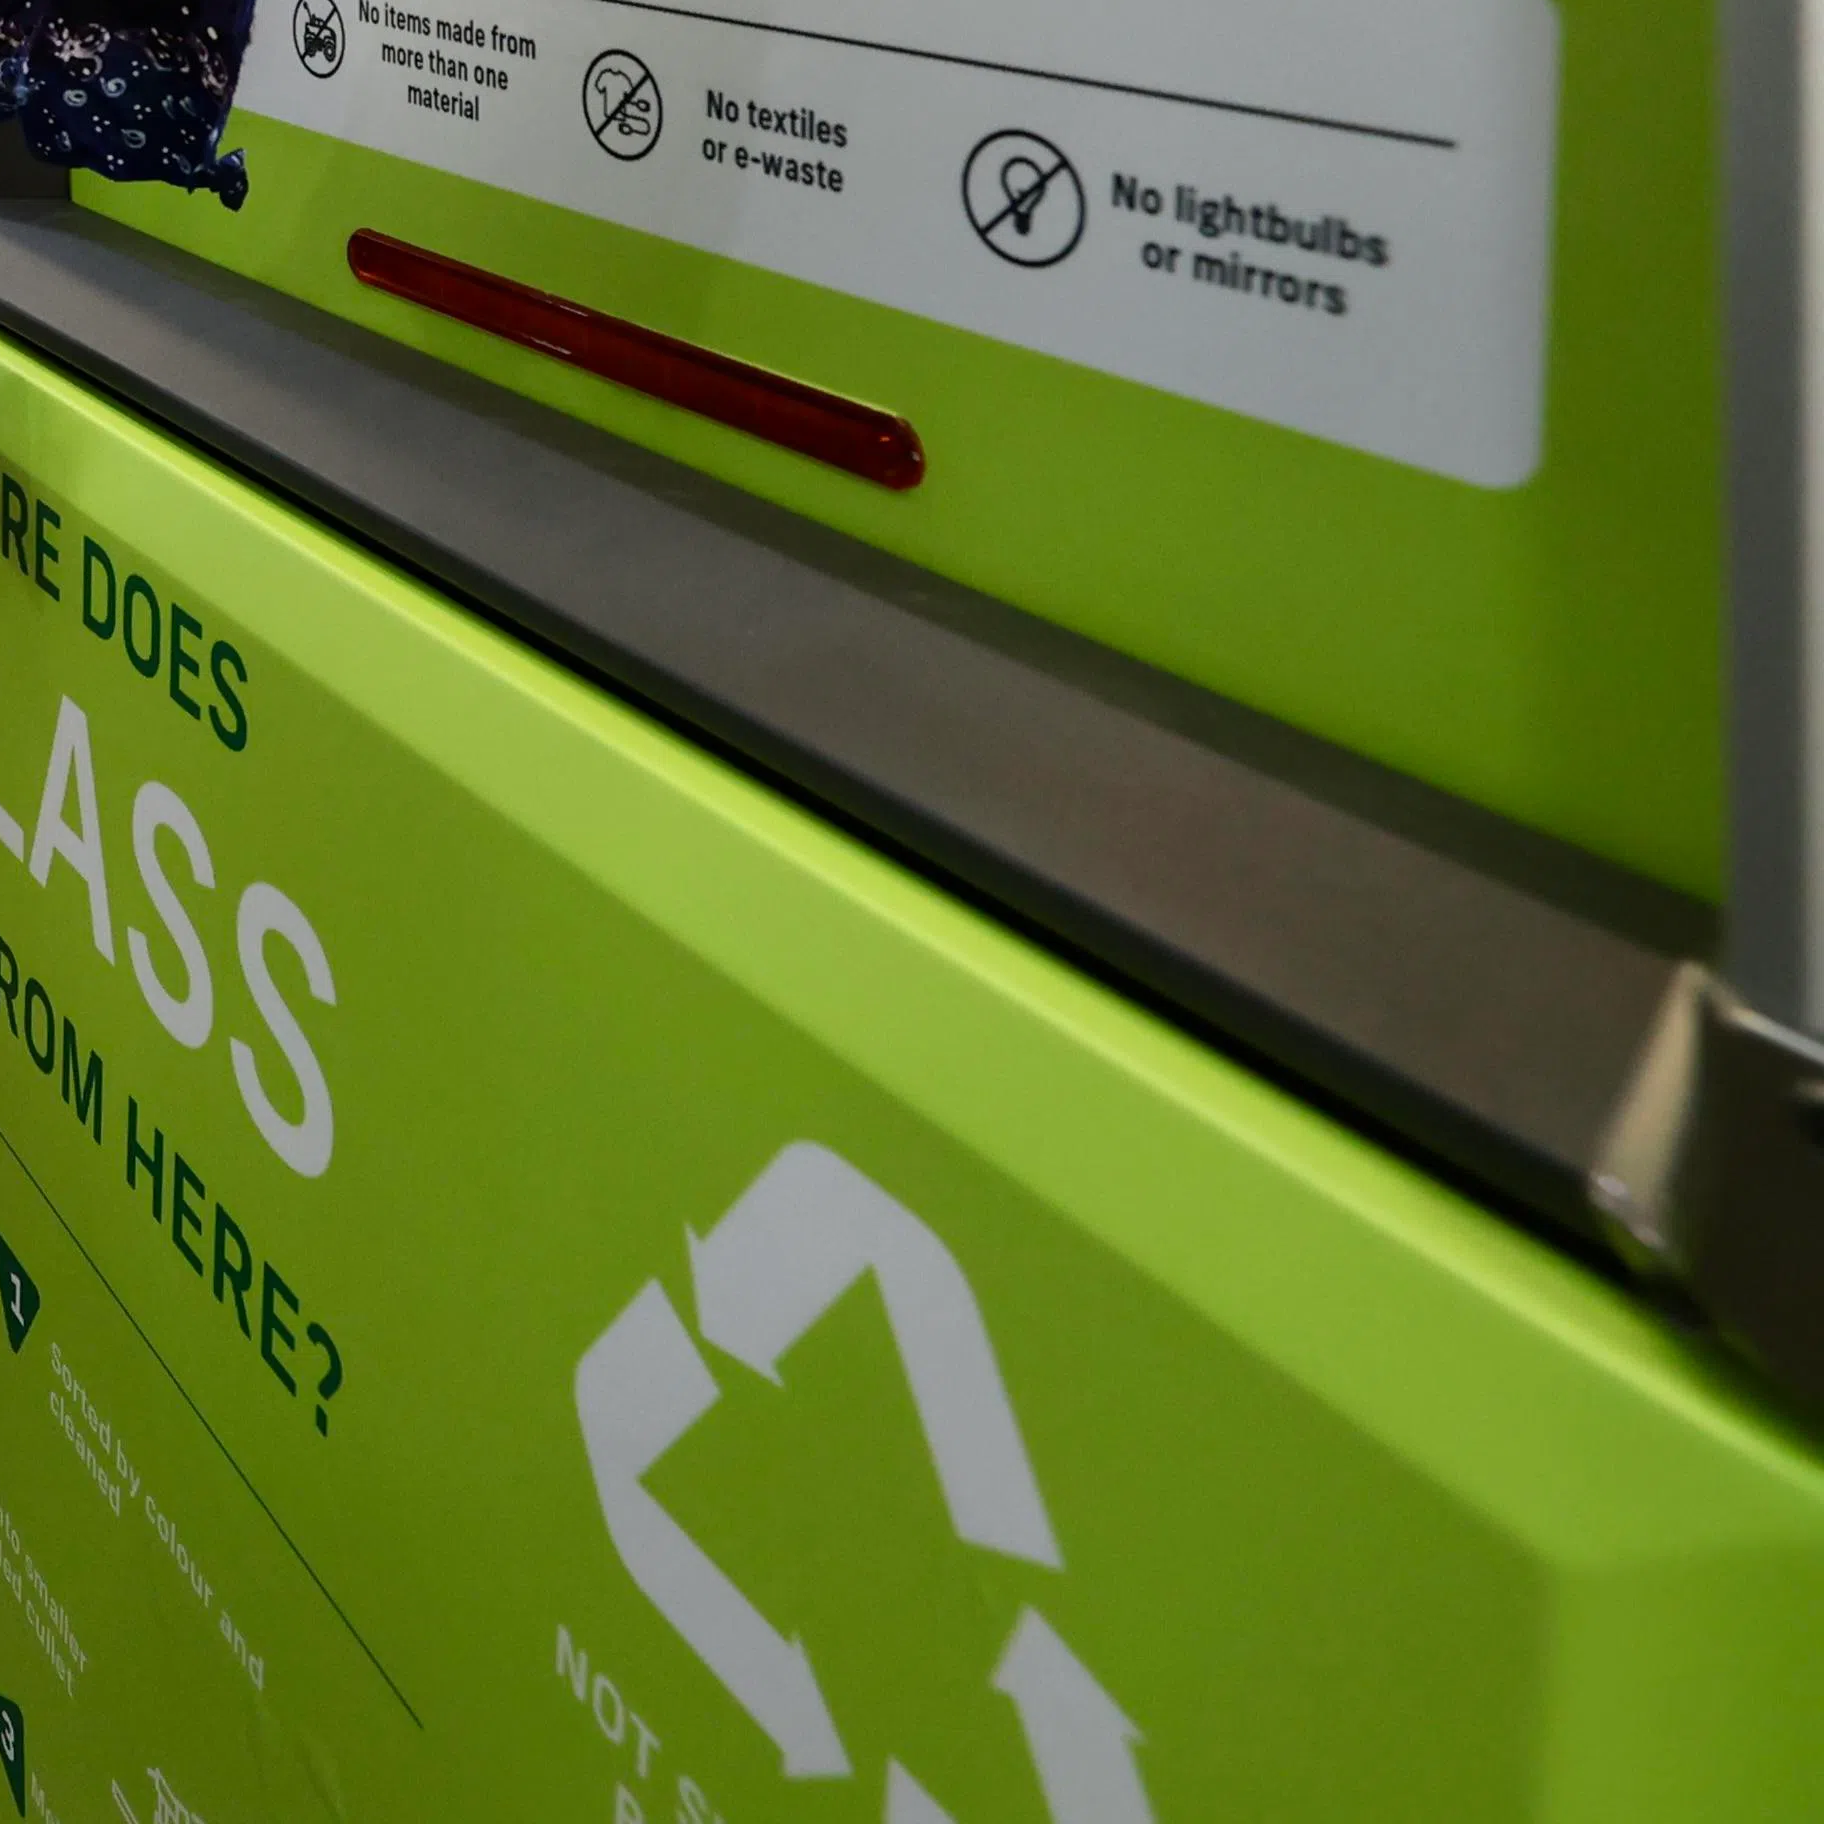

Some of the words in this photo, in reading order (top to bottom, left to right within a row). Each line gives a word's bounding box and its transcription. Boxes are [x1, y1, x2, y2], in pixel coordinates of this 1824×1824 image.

[382, 41, 424, 70] more
[429, 49, 468, 83] than
[474, 64, 509, 91] one
[385, 2, 431, 36] items
[437, 19, 485, 48] made
[492, 24, 537, 60] from
[407, 84, 480, 121] material
[705, 88, 740, 124] No
[748, 99, 849, 150] textiles
[702, 137, 727, 163] or
[734, 142, 845, 194] e-waste
[1110, 171, 1163, 216] No
[1174, 182, 1392, 268] lightbulbs
[1141, 236, 1182, 275] or
[1192, 251, 1350, 317] mirrors
[83, 533, 249, 753] DOES
[10, 1273, 25, 1327] 1
[125, 1093, 344, 1439] HERE?
[50, 1391, 120, 1517] cleaned
[51, 1341, 111, 1455] Sorted
[116, 1439, 141, 1498] by
[145, 1495, 213, 1608] colour
[219, 1608, 264, 1692] and
[25, 1554, 87, 1673] smaller
[26, 1600, 73, 1699] cullet
[1, 1709, 16, 1763] 3
[555, 1622, 662, 1780] NOT
